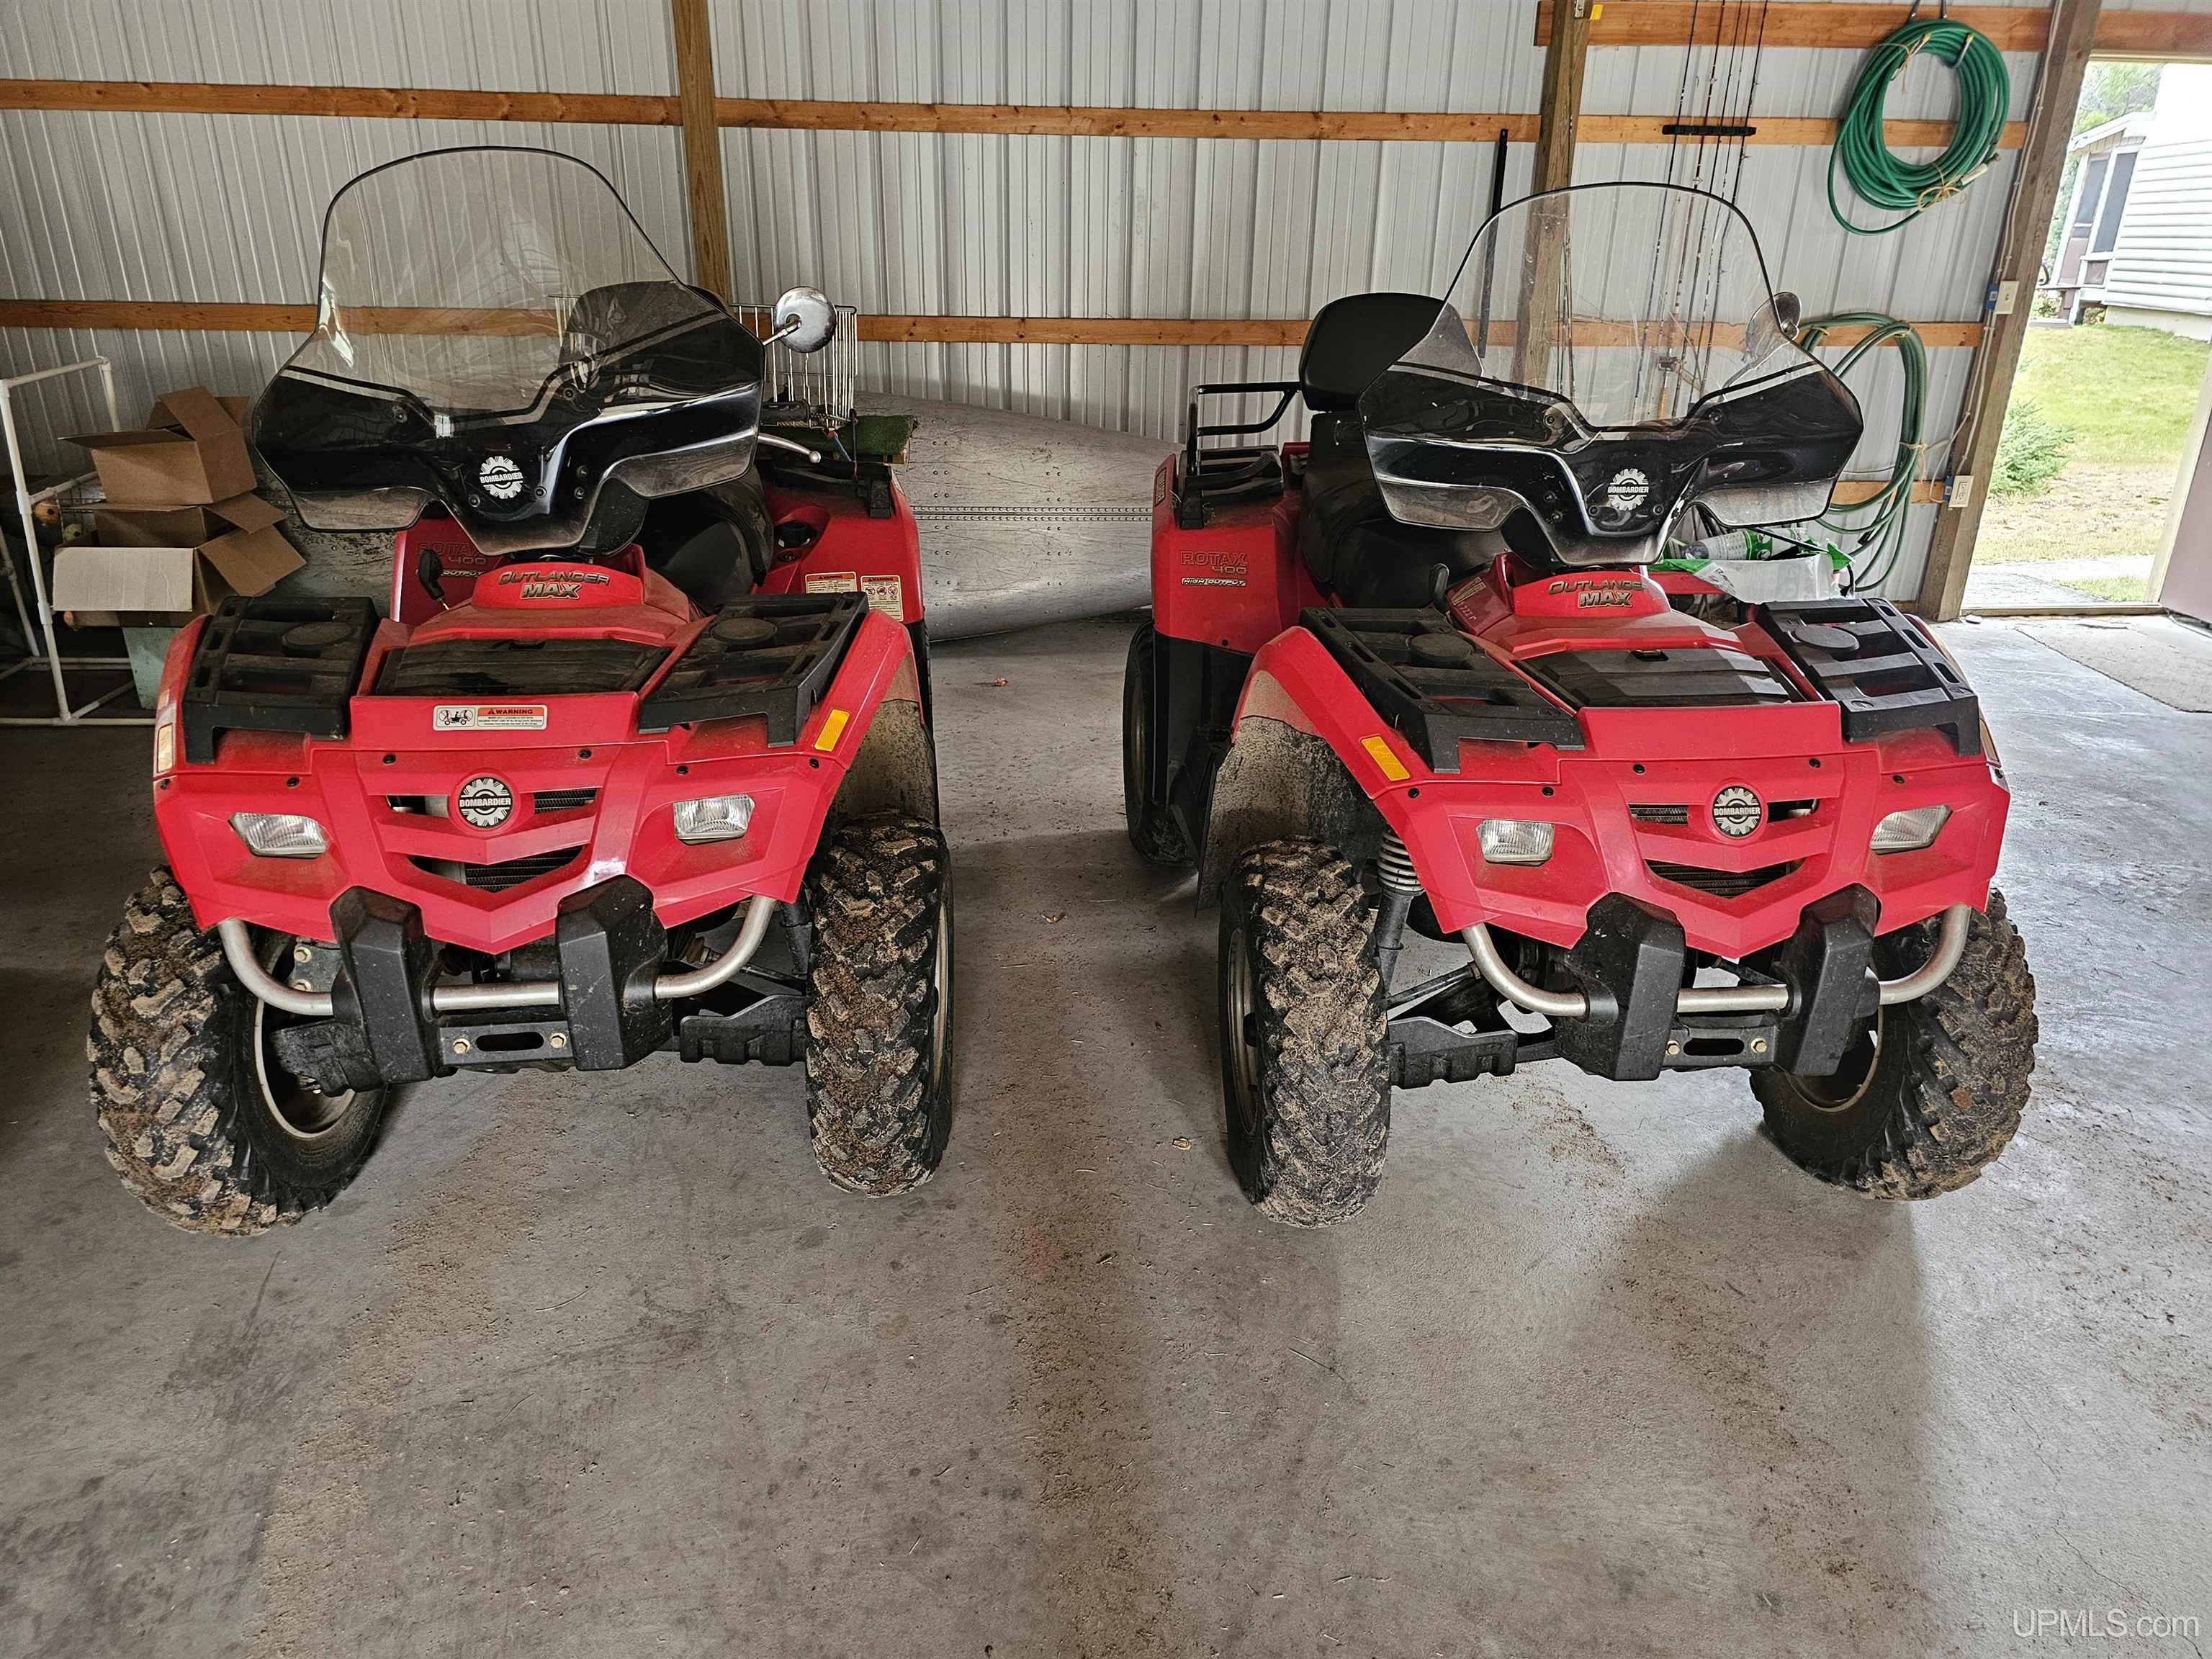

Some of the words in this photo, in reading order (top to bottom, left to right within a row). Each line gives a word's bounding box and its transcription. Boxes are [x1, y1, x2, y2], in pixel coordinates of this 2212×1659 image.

[480, 472, 523, 484] BOMBARDIER
[449, 556, 485, 565] 400
[1181, 552, 1247, 566] ROTAX
[1212, 565, 1248, 575] 400
[498, 571, 611, 585] OUTLANDER
[520, 582, 582, 599] MAX
[1578, 590, 1632, 608] MAX
[459, 798, 511, 807] BOMBARDIER
[1714, 807, 1761, 816] BOMBARDIER
